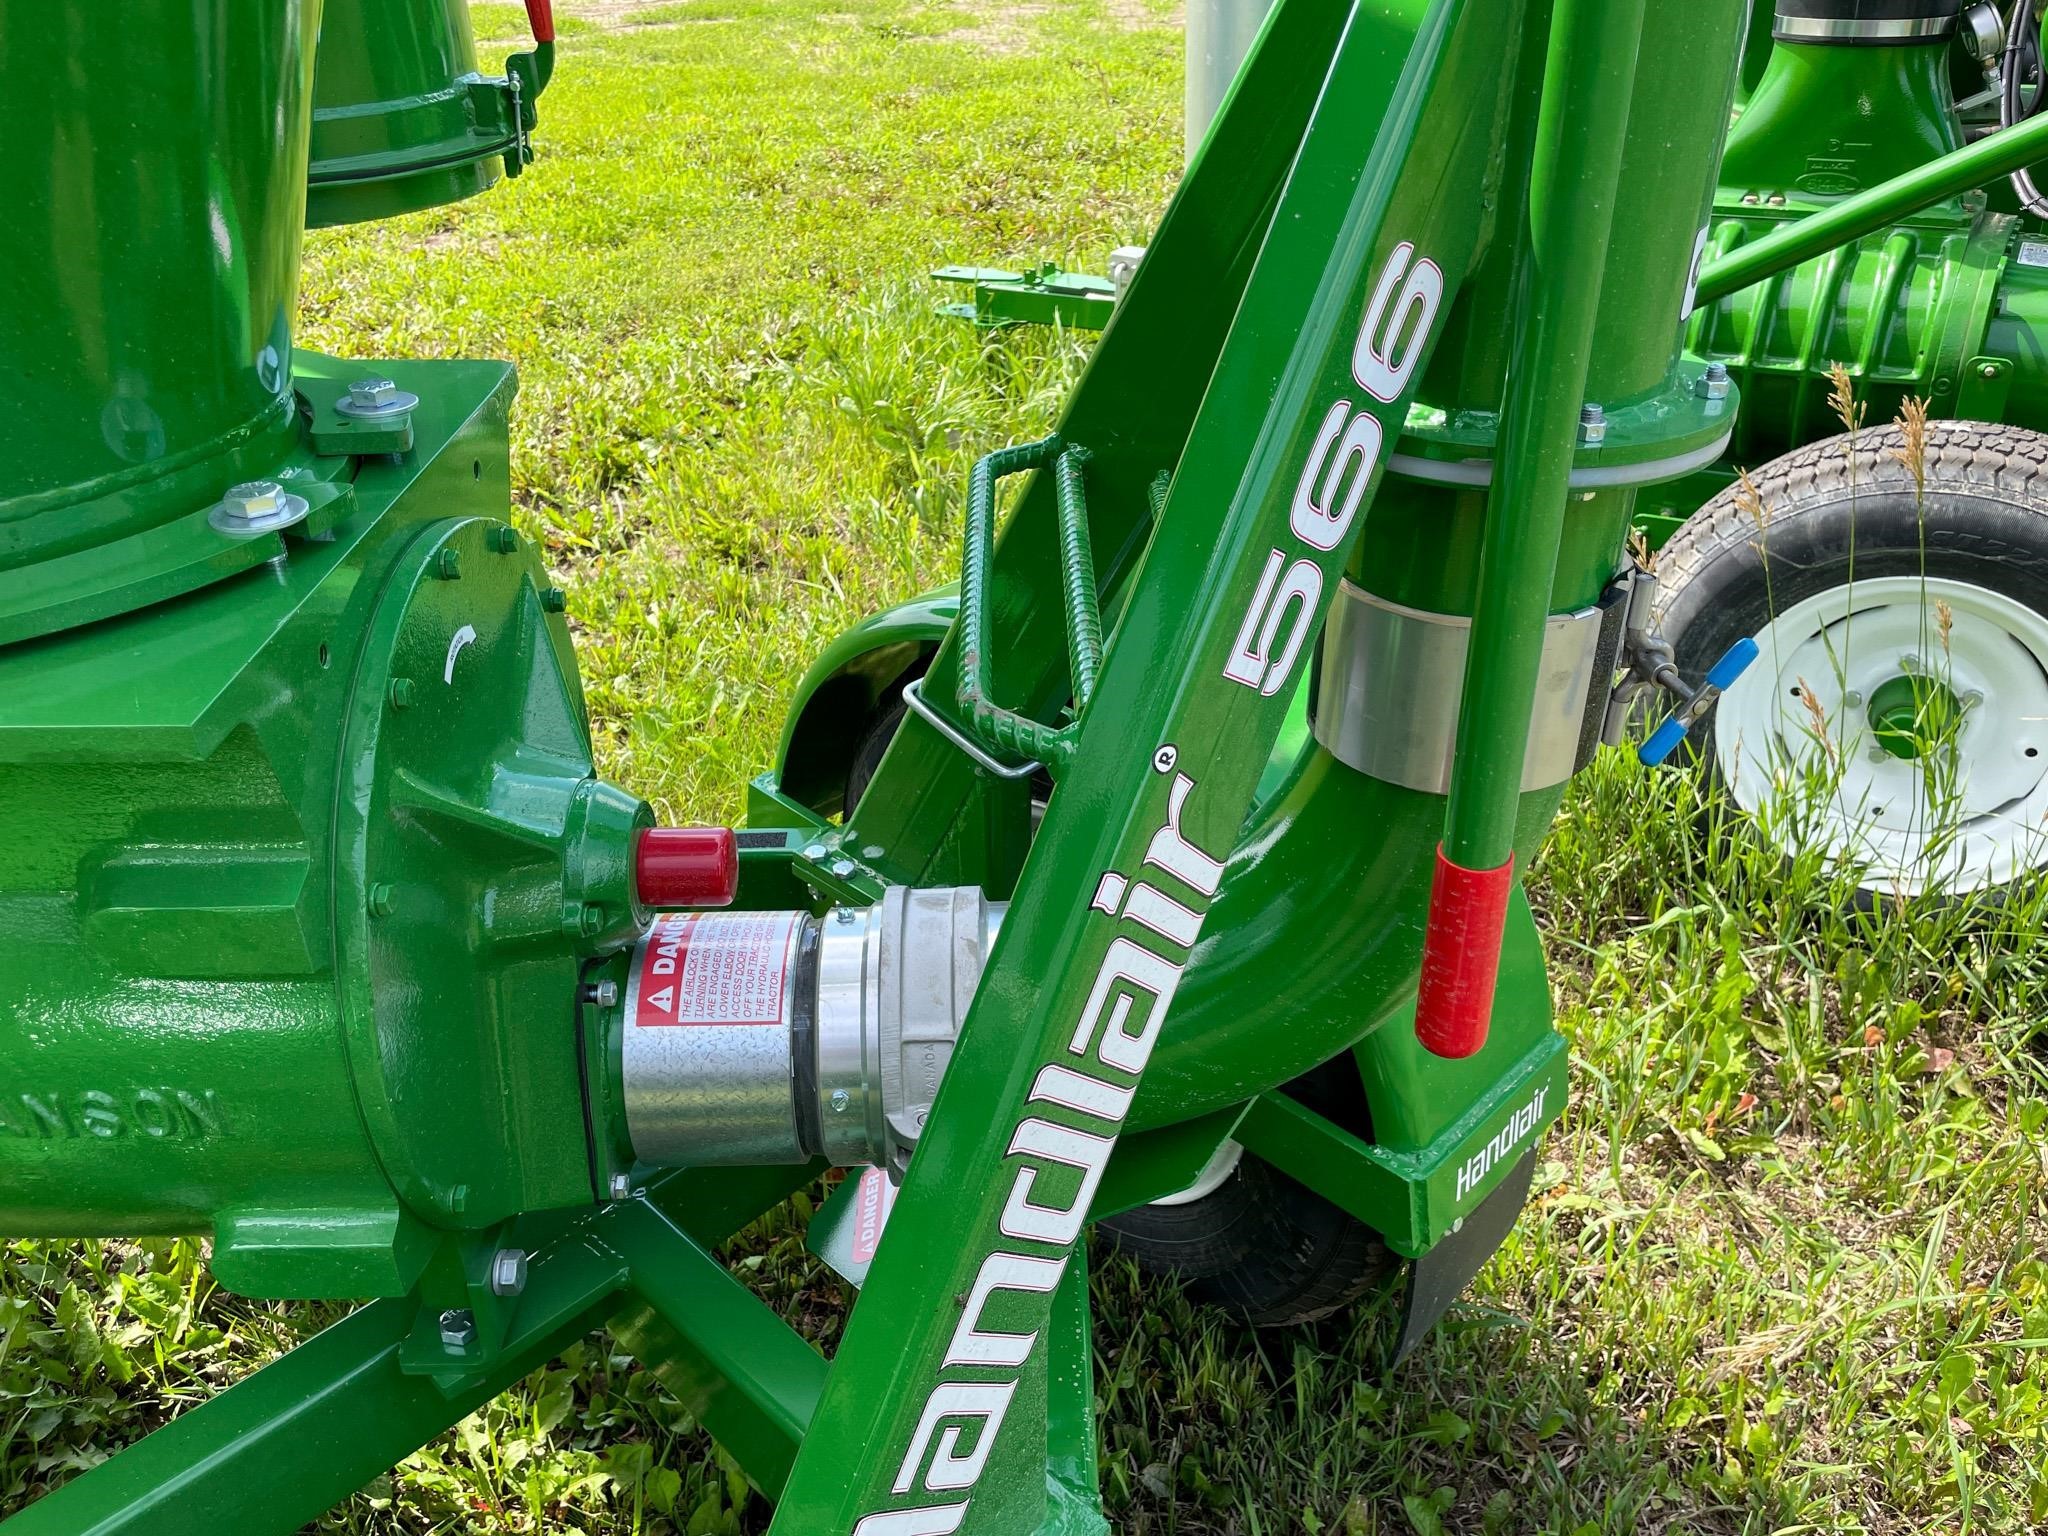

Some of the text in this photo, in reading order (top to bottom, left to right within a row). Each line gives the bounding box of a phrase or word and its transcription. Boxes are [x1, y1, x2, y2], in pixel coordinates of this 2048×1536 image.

[1223, 240, 1444, 697] 566
[652, 913, 690, 974] DANGE
[685, 958, 698, 997] AIRLOCK
[724, 950, 736, 980] ELBOW
[736, 951, 747, 976] DOOR
[745, 968, 756, 995] YOUR
[682, 998, 692, 1018] THE
[694, 974, 707, 1018] TURNING
[707, 998, 717, 1018] ARE
[719, 981, 731, 1018] LOWER
[731, 978, 743, 1018] ACCESS
[743, 998, 752, 1018] OFF
[756, 996, 765, 1017] THE
[1456, 1085, 1550, 1202] Handlair
[860, 1172, 880, 1242] DANGER
